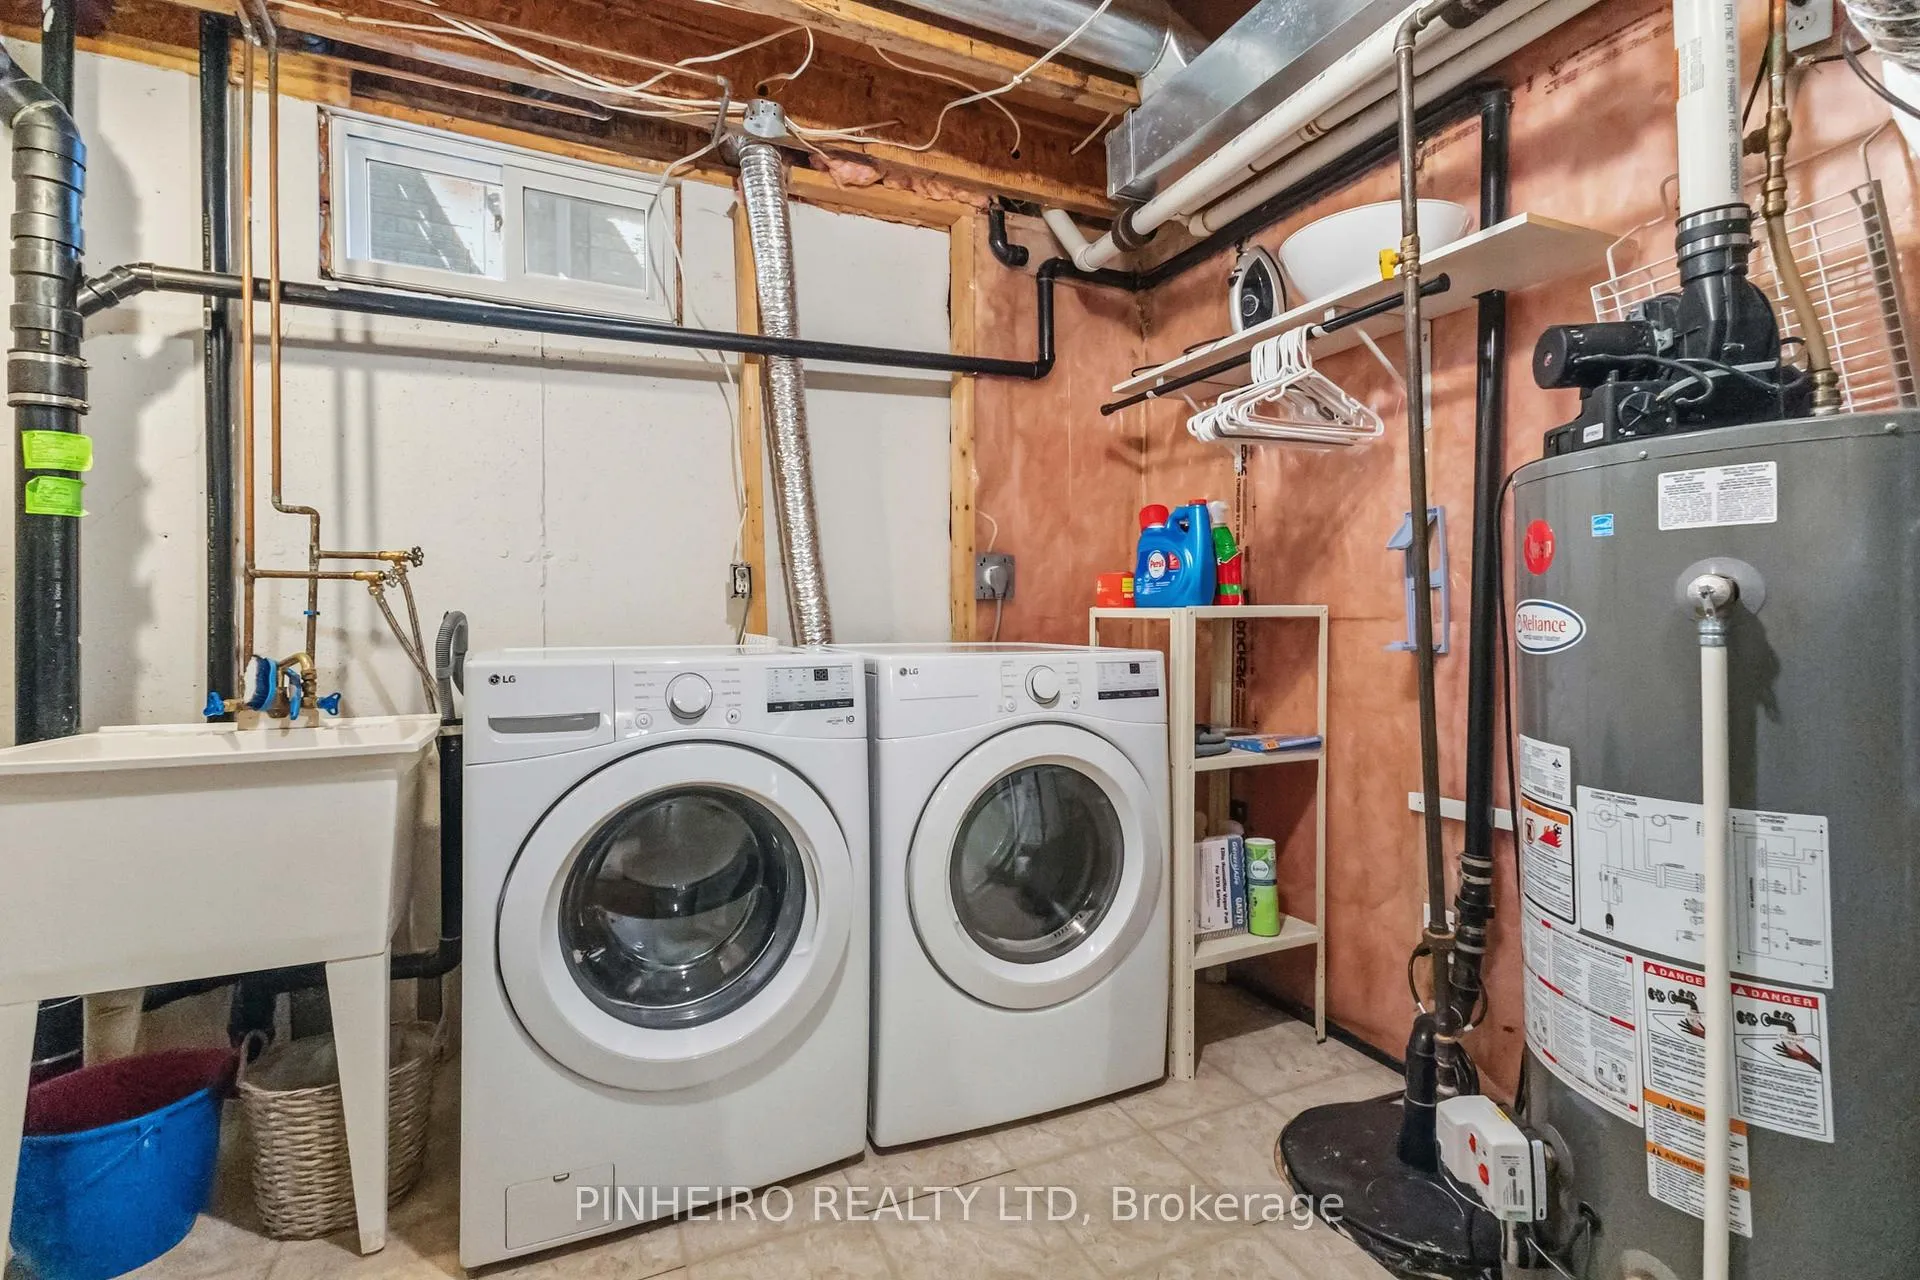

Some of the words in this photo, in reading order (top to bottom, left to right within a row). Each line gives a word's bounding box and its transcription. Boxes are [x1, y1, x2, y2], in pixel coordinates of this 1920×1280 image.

[1522, 613, 1567, 633] Reliance
[502, 675, 517, 684] LG
[908, 667, 919, 676] LG
[1659, 969, 1704, 986] DANGE
[1751, 990, 1814, 1008] DANGER
